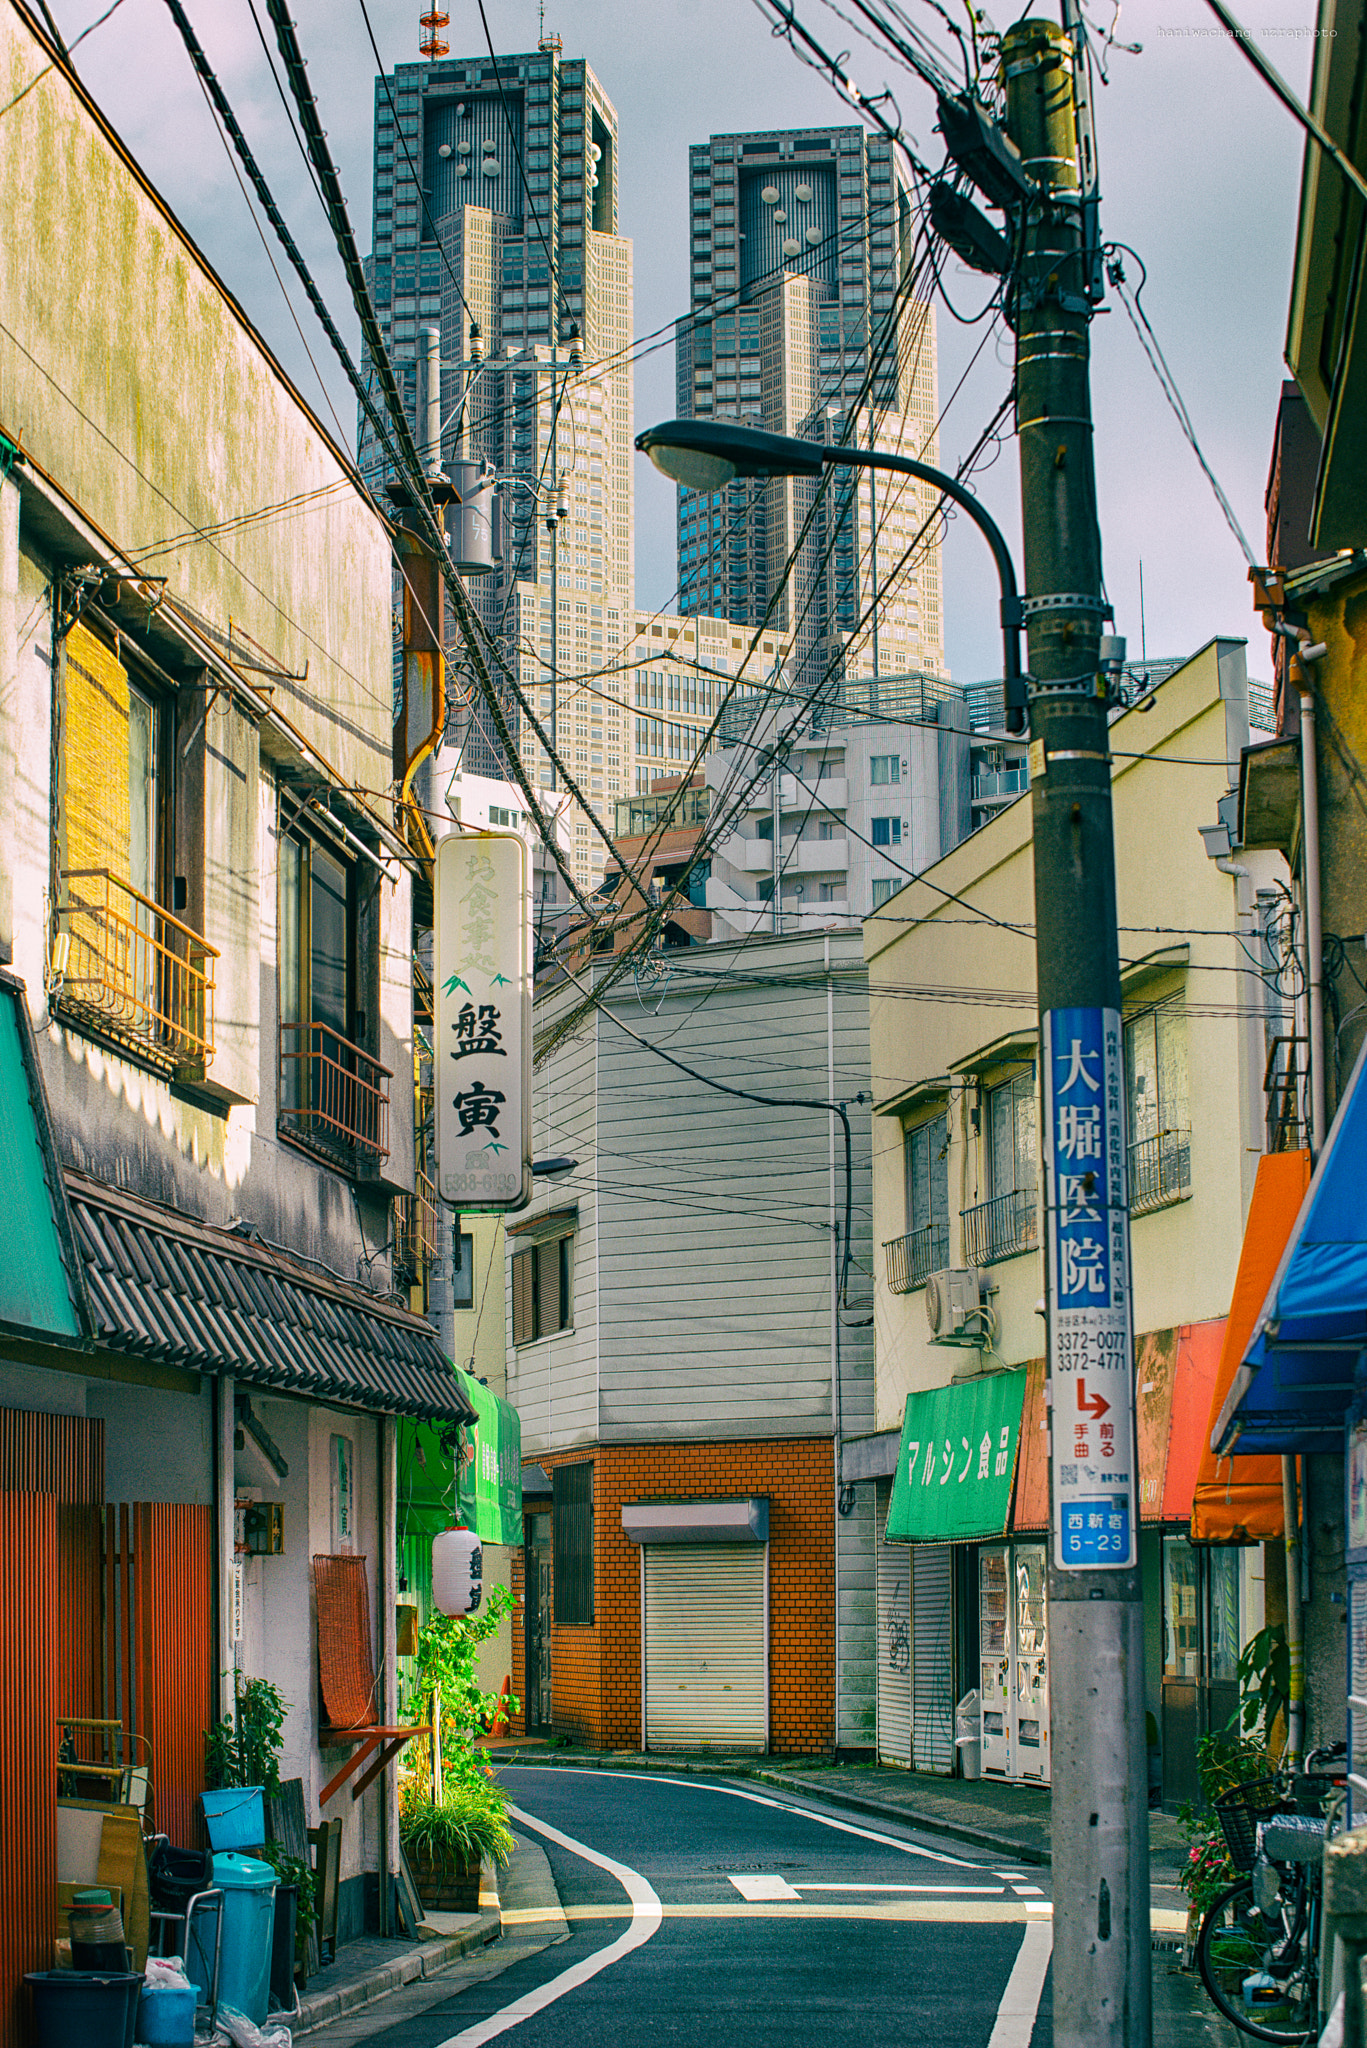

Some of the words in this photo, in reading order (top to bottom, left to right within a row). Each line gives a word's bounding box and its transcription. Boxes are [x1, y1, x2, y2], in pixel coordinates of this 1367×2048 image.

[472, 527, 488, 542] 75
[453, 855, 498, 976] お食事処
[450, 1002, 507, 1138] 盤寅
[1056, 1039, 1105, 1296] 大堀医院
[1057, 1331, 1126, 1350] 3372-0077
[1057, 1352, 1126, 1371] 3372-4771
[908, 1426, 1009, 1486] マルシン食品
[1068, 1513, 1123, 1529] 西新宿
[1070, 1535, 1122, 1551] 5-23
